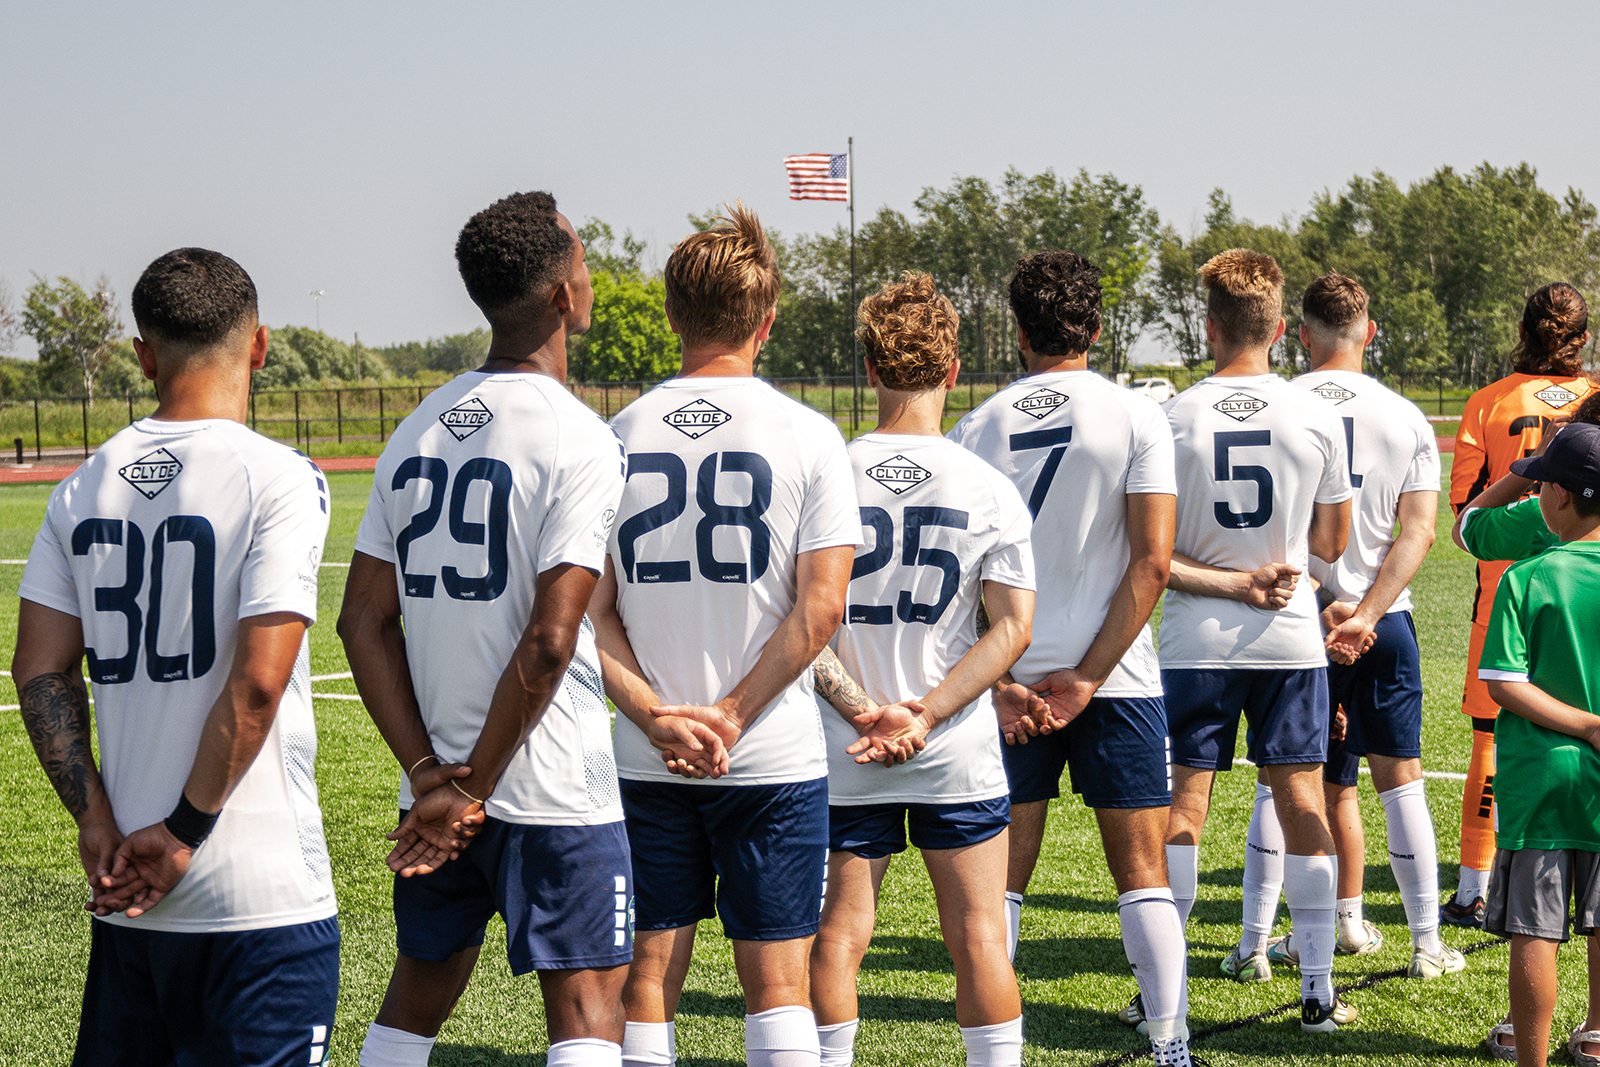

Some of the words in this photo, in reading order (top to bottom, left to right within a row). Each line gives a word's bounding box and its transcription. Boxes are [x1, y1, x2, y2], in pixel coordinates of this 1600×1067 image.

[1021, 396, 1061, 409] CLYDE
[1540, 392, 1572, 401] CLYDE
[1221, 401, 1260, 411] CLYDE
[447, 411, 486, 425] CLYDE
[673, 412, 722, 424] CLYDE
[130, 463, 177, 480] CLYDE
[876, 468, 921, 480] CLYDE
[1009, 425, 1072, 524] 7
[1213, 429, 1274, 529] 5
[617, 451, 773, 584] 28
[391, 455, 512, 601] 29
[841, 506, 969, 625] 25
[71, 514, 216, 685] 30
